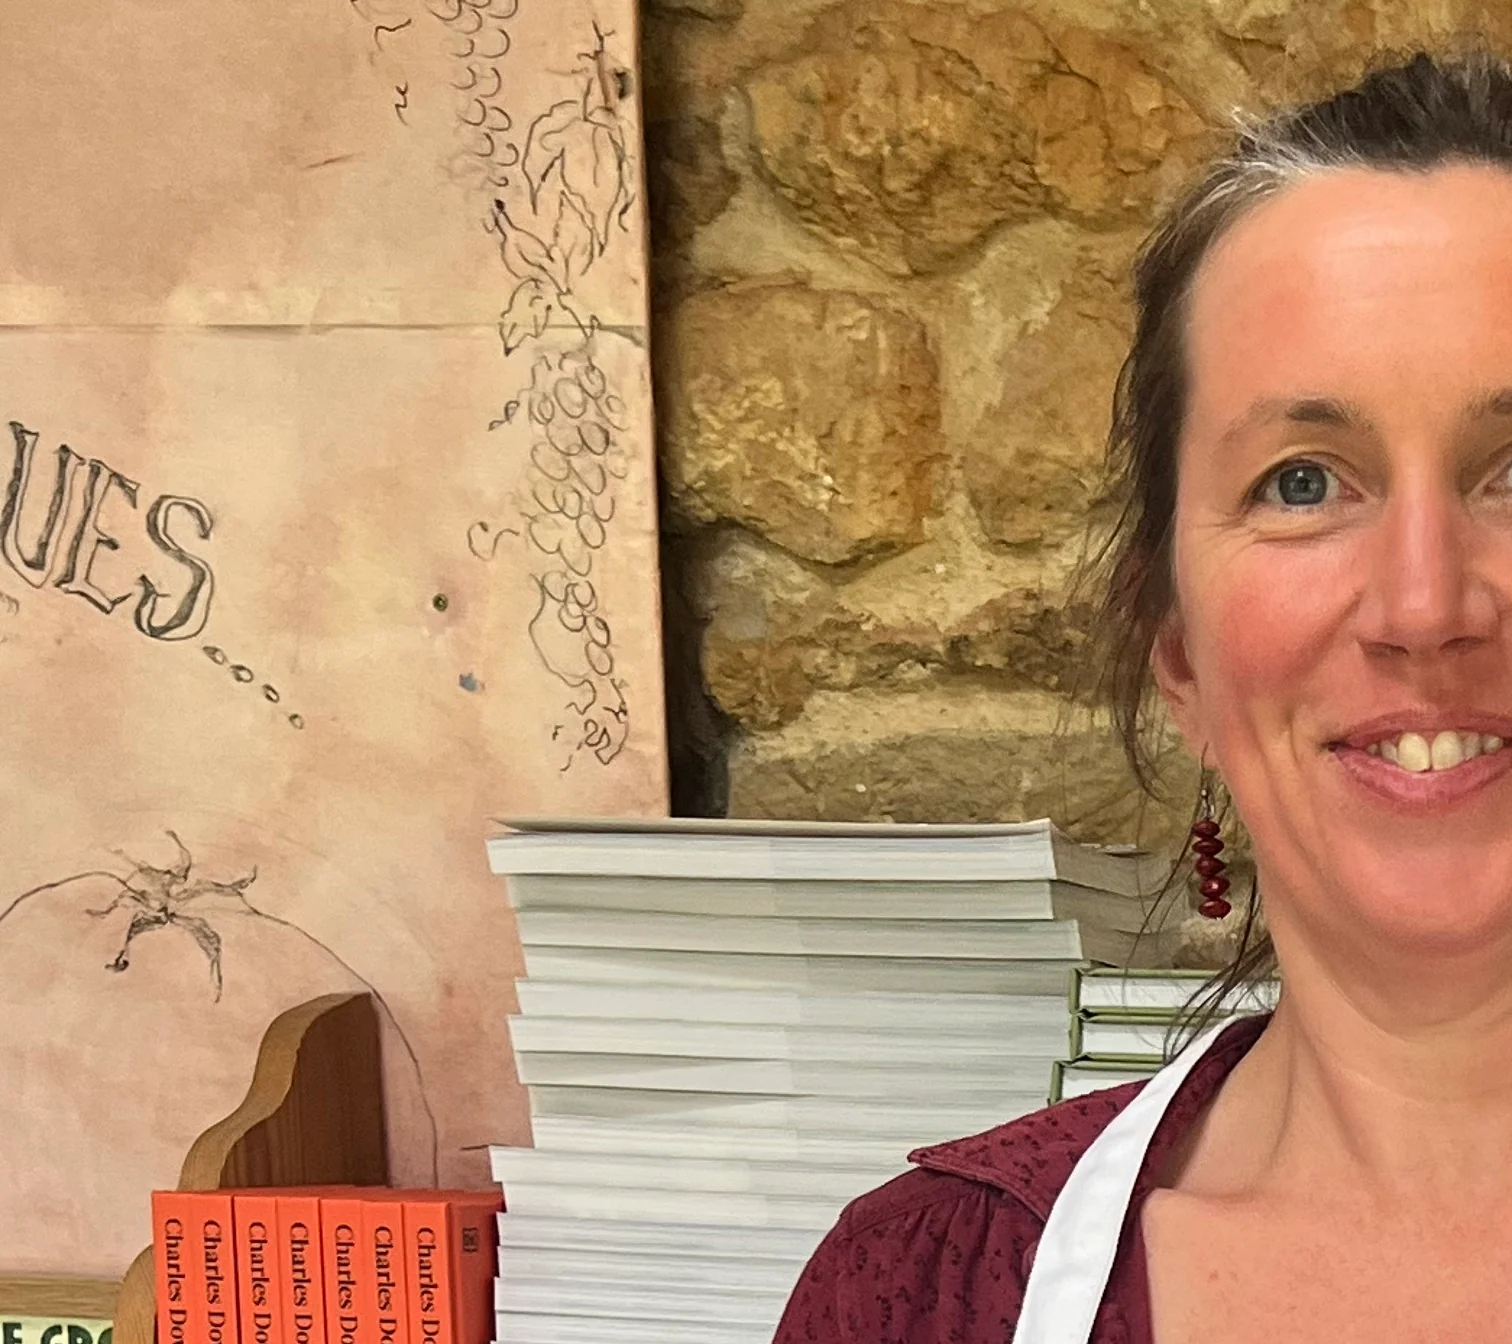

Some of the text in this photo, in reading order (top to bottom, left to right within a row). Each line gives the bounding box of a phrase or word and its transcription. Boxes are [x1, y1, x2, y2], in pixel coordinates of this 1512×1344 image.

[164, 1218, 187, 1302] Charles
[203, 1220, 225, 1304] Charles
[249, 1221, 268, 1307] Charles
[290, 1223, 314, 1308] Charles
[335, 1224, 354, 1309] Charles
[375, 1226, 395, 1311] Charles
[417, 1227, 437, 1312] Charles
